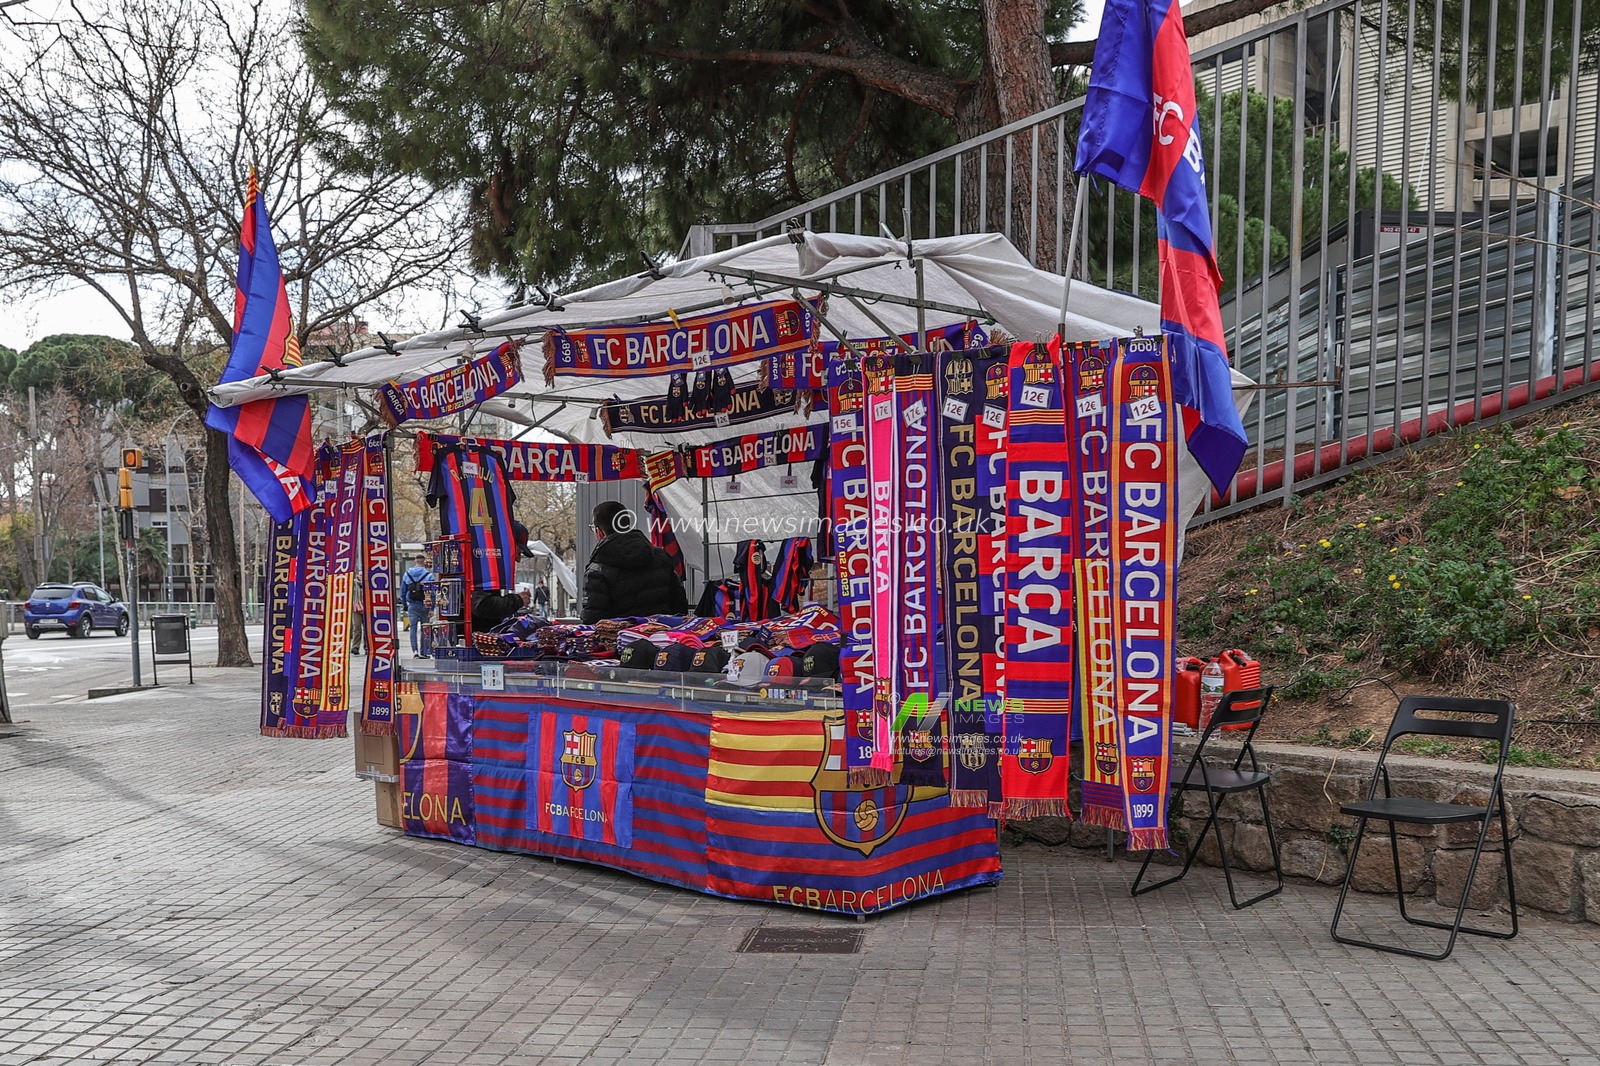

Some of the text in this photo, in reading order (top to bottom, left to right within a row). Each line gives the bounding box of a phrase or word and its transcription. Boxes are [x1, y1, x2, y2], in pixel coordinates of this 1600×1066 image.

[593, 338, 621, 366] FC
[625, 315, 770, 365] BARCELONA
[694, 354, 708, 366] 12€
[801, 353, 823, 377] FC
[403, 386, 420, 409] FC
[420, 361, 500, 408] BARCELONA
[1023, 390, 1045, 403] 12€
[640, 405, 660, 424] FC
[715, 415, 727, 423] 12€
[876, 405, 888, 416] 17€
[906, 406, 921, 422] 17€
[946, 403, 963, 416] 12€
[984, 411, 1001, 424] 12€
[1079, 401, 1096, 413] 12€
[1133, 401, 1156, 416] 12€
[834, 419, 852, 429] 15€
[702, 431, 815, 468] FC BARCELONA
[576, 473, 587, 481] 12€
[341, 482, 356, 514] FC
[470, 487, 493, 533] 4
[872, 480, 891, 593] BARÇA
[904, 408, 929, 688] FC BARCELONA
[949, 424, 981, 704] FC BARCELONA
[1009, 470, 1063, 654] BARÇA
[369, 484, 393, 673] FC BARCELONA
[843, 478, 873, 694] BARCELONA
[1124, 416, 1163, 744] FC BARCELONA
[271, 535, 292, 675] BARCELONA
[299, 531, 326, 679] BARCELONA
[329, 521, 351, 677] BARCELONA
[1082, 470, 1116, 727] BARCELONA
[723, 635, 735, 643] 17€
[371, 705, 389, 716] 1899
[570, 756, 587, 764] FCB
[402, 792, 467, 826] ELONA
[1133, 804, 1154, 818] 1899
